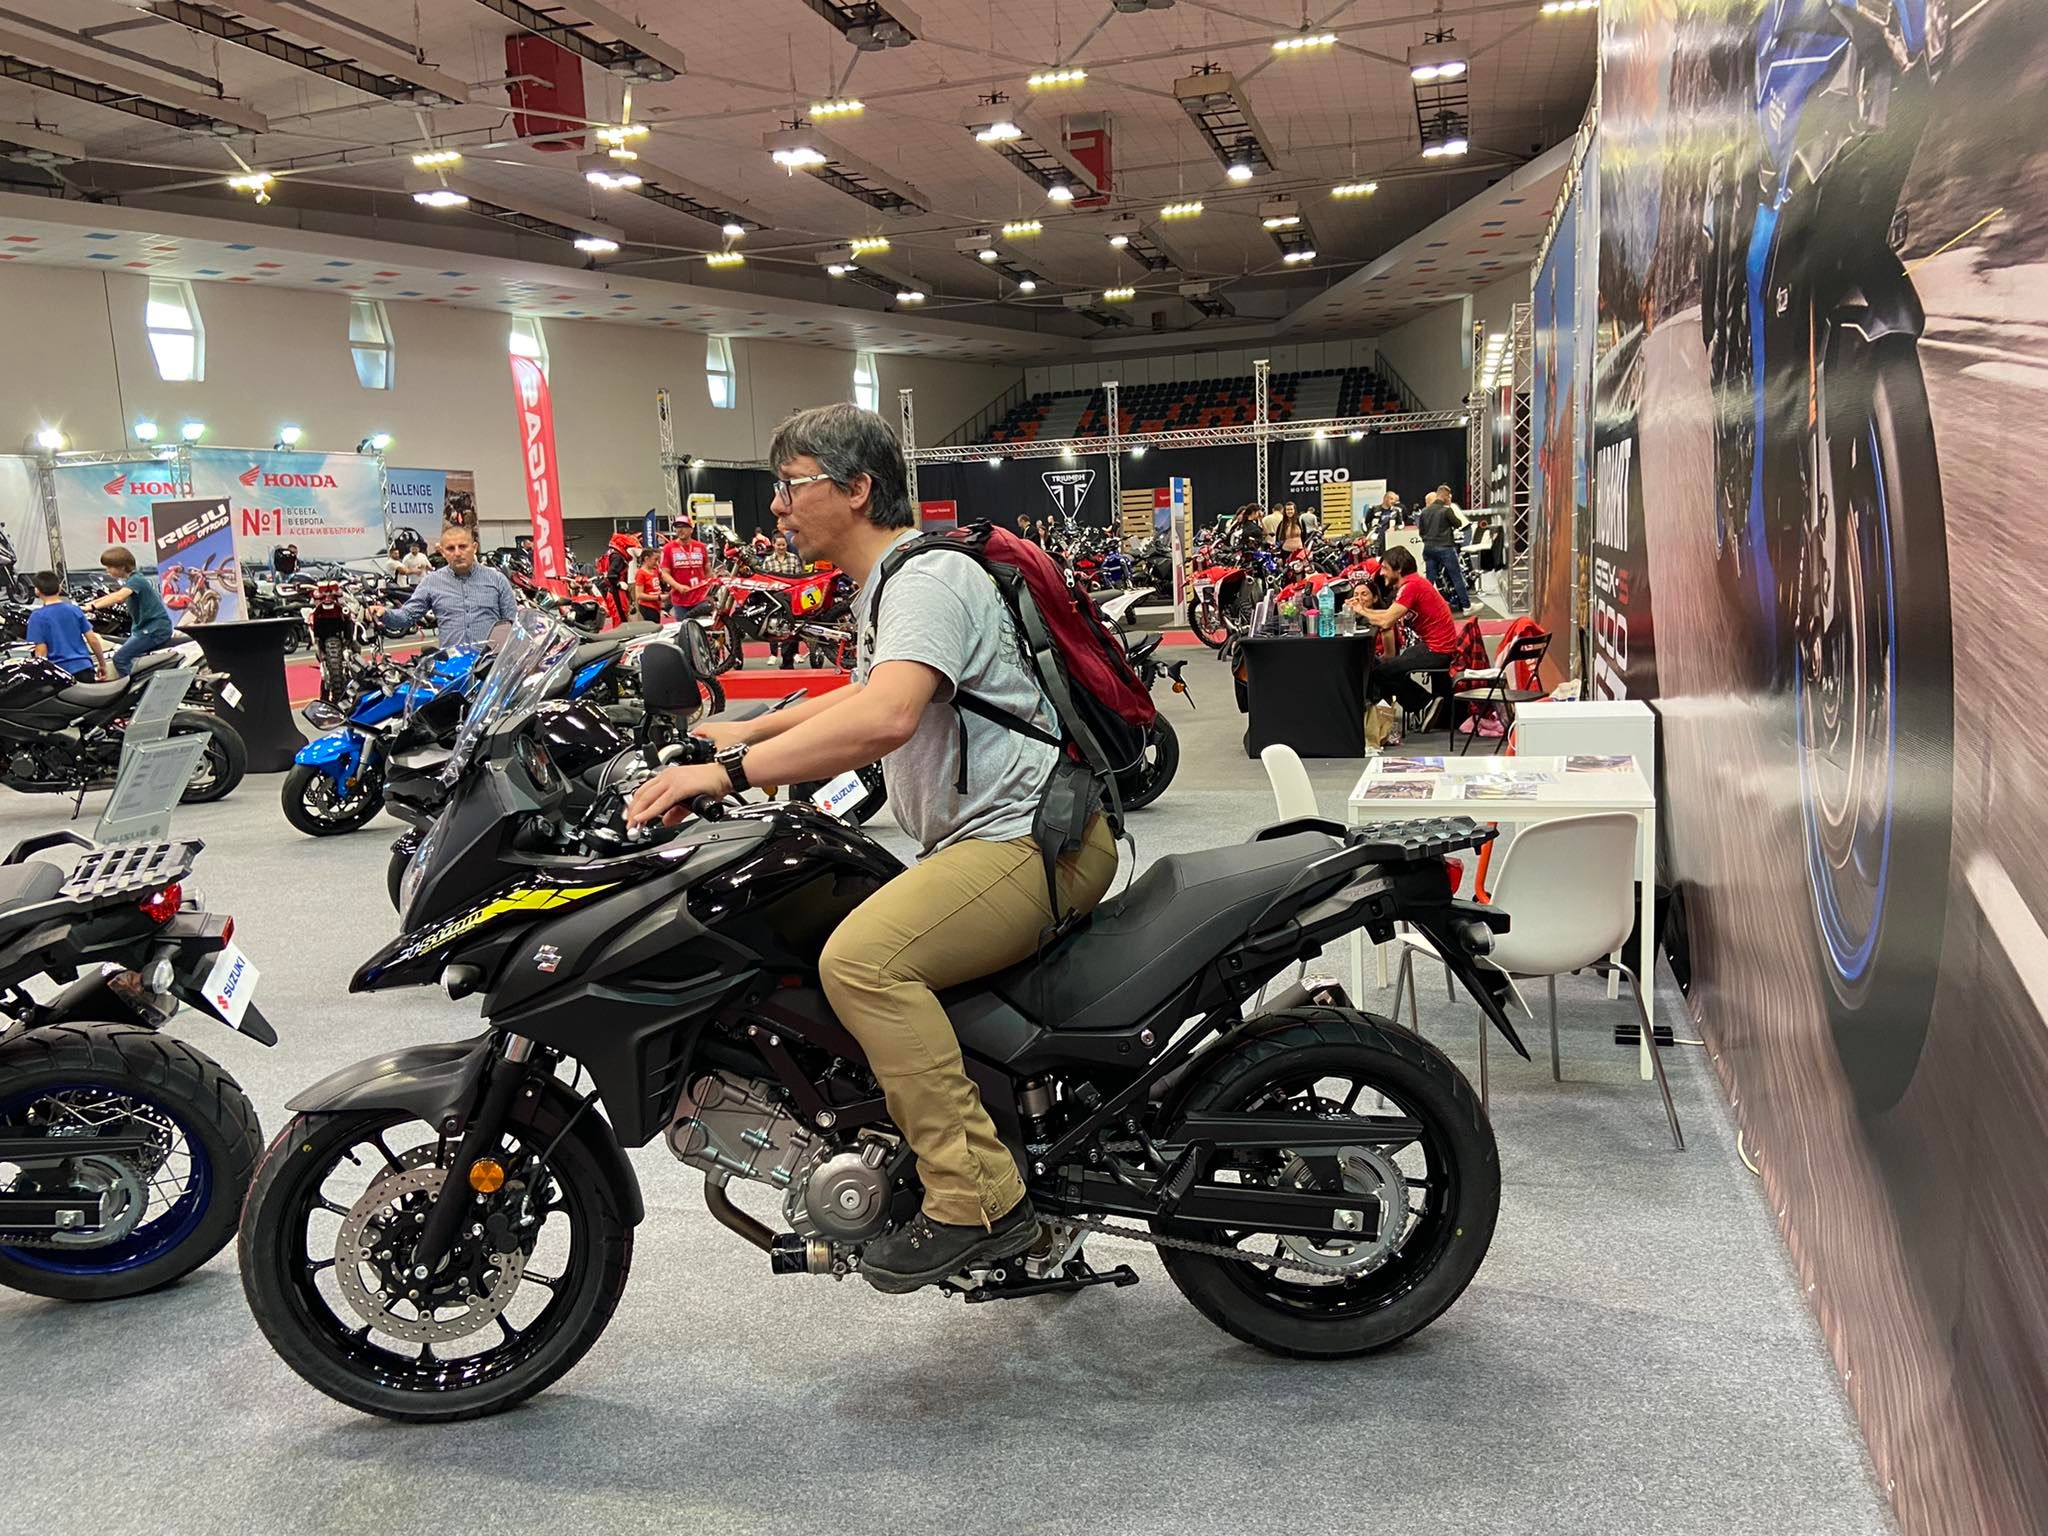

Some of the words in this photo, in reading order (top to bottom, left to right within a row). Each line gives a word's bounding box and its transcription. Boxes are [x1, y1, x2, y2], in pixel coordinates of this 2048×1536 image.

[263, 473, 338, 488] HONDA
[1051, 474, 1085, 482] TRIUMPH
[1290, 468, 1350, 486] ZERO
[389, 483, 432, 496] ALLENGE
[399, 502, 434, 514] LIMITS
[157, 503, 227, 550] RIEJU
[807, 593, 817, 606] 3
[831, 779, 860, 805] SUZUKI
[223, 956, 246, 998] SUZUKI
